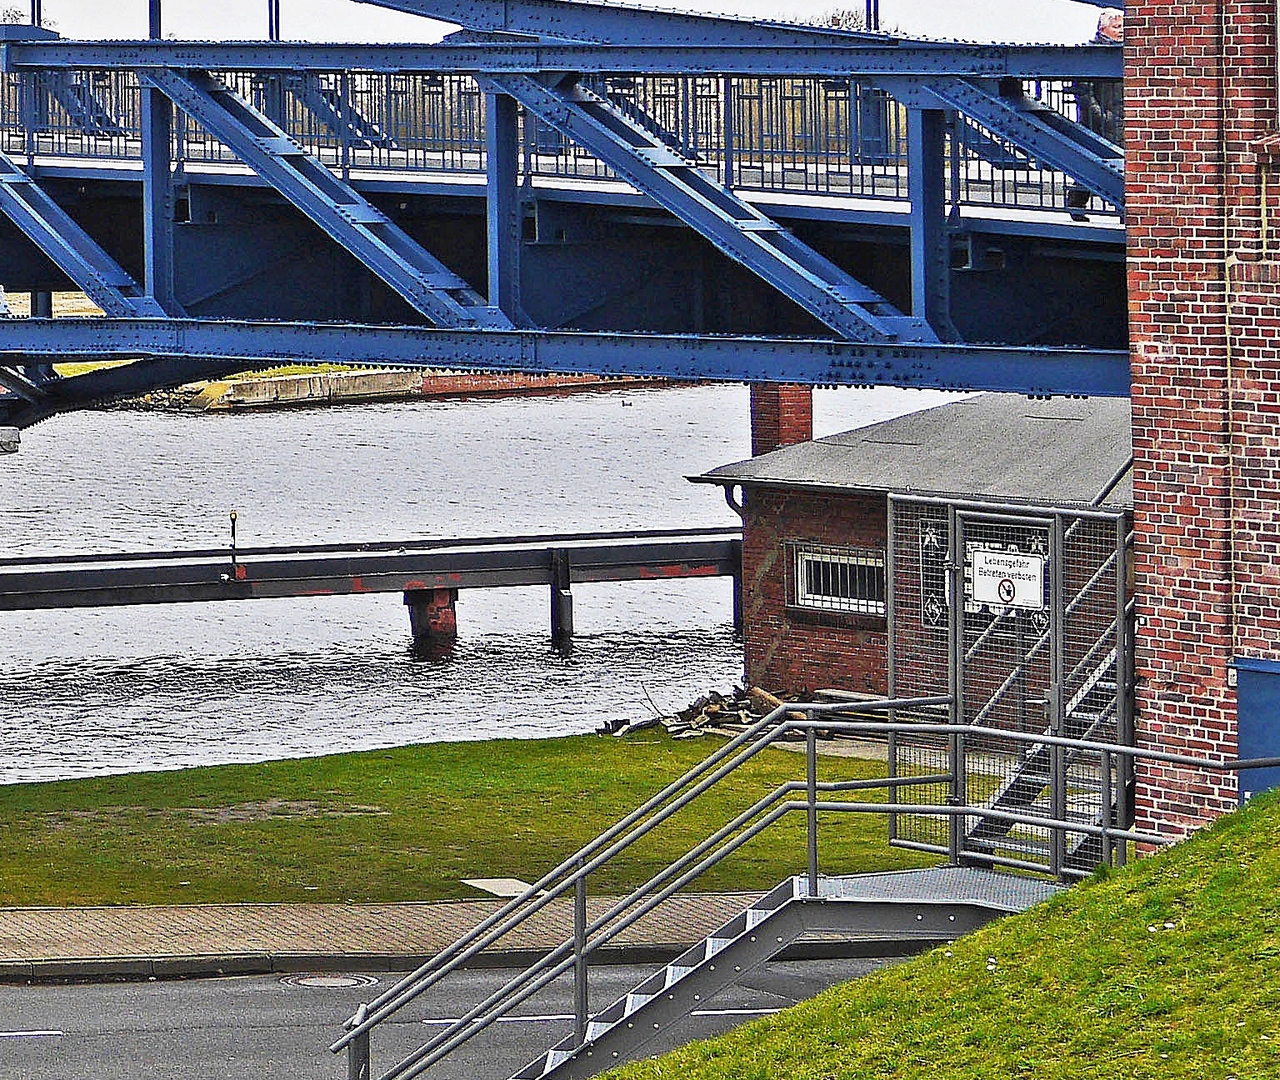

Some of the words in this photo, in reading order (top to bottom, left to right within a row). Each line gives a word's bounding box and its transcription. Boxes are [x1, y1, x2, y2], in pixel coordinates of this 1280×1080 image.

[984, 556, 1030, 569] Lebensgefahr
[978, 567, 1007, 578] Betreten
[1007, 570, 1037, 582] verboten
